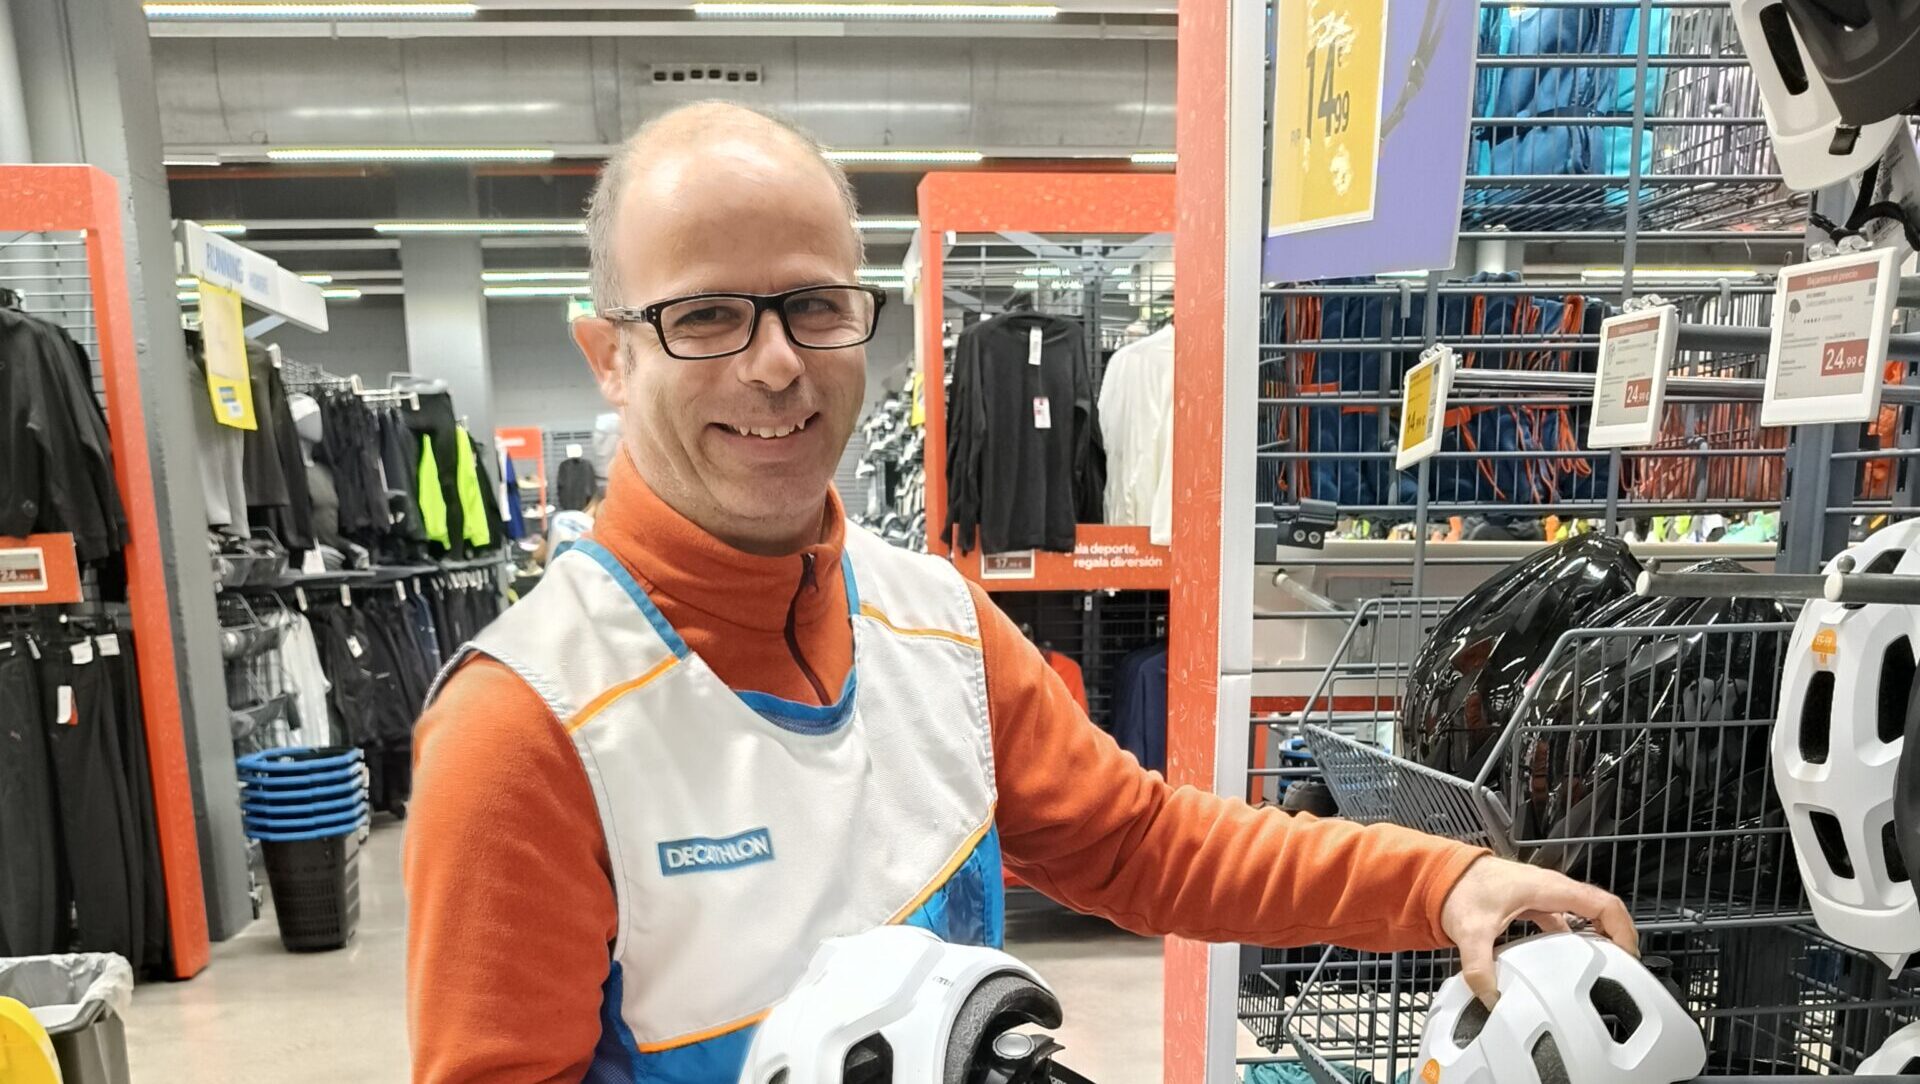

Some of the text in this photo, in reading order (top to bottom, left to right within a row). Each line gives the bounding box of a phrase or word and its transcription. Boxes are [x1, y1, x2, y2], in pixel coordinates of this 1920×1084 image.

[1306, 38, 1337, 144] 14
[1334, 91, 1350, 134] 99
[1824, 347, 1858, 371] 24,99
[1858, 355, 1865, 368] €
[1089, 542, 1139, 557] deporte,
[1073, 555, 1163, 570] regala diversión
[666, 836, 770, 868] DECATHLON
